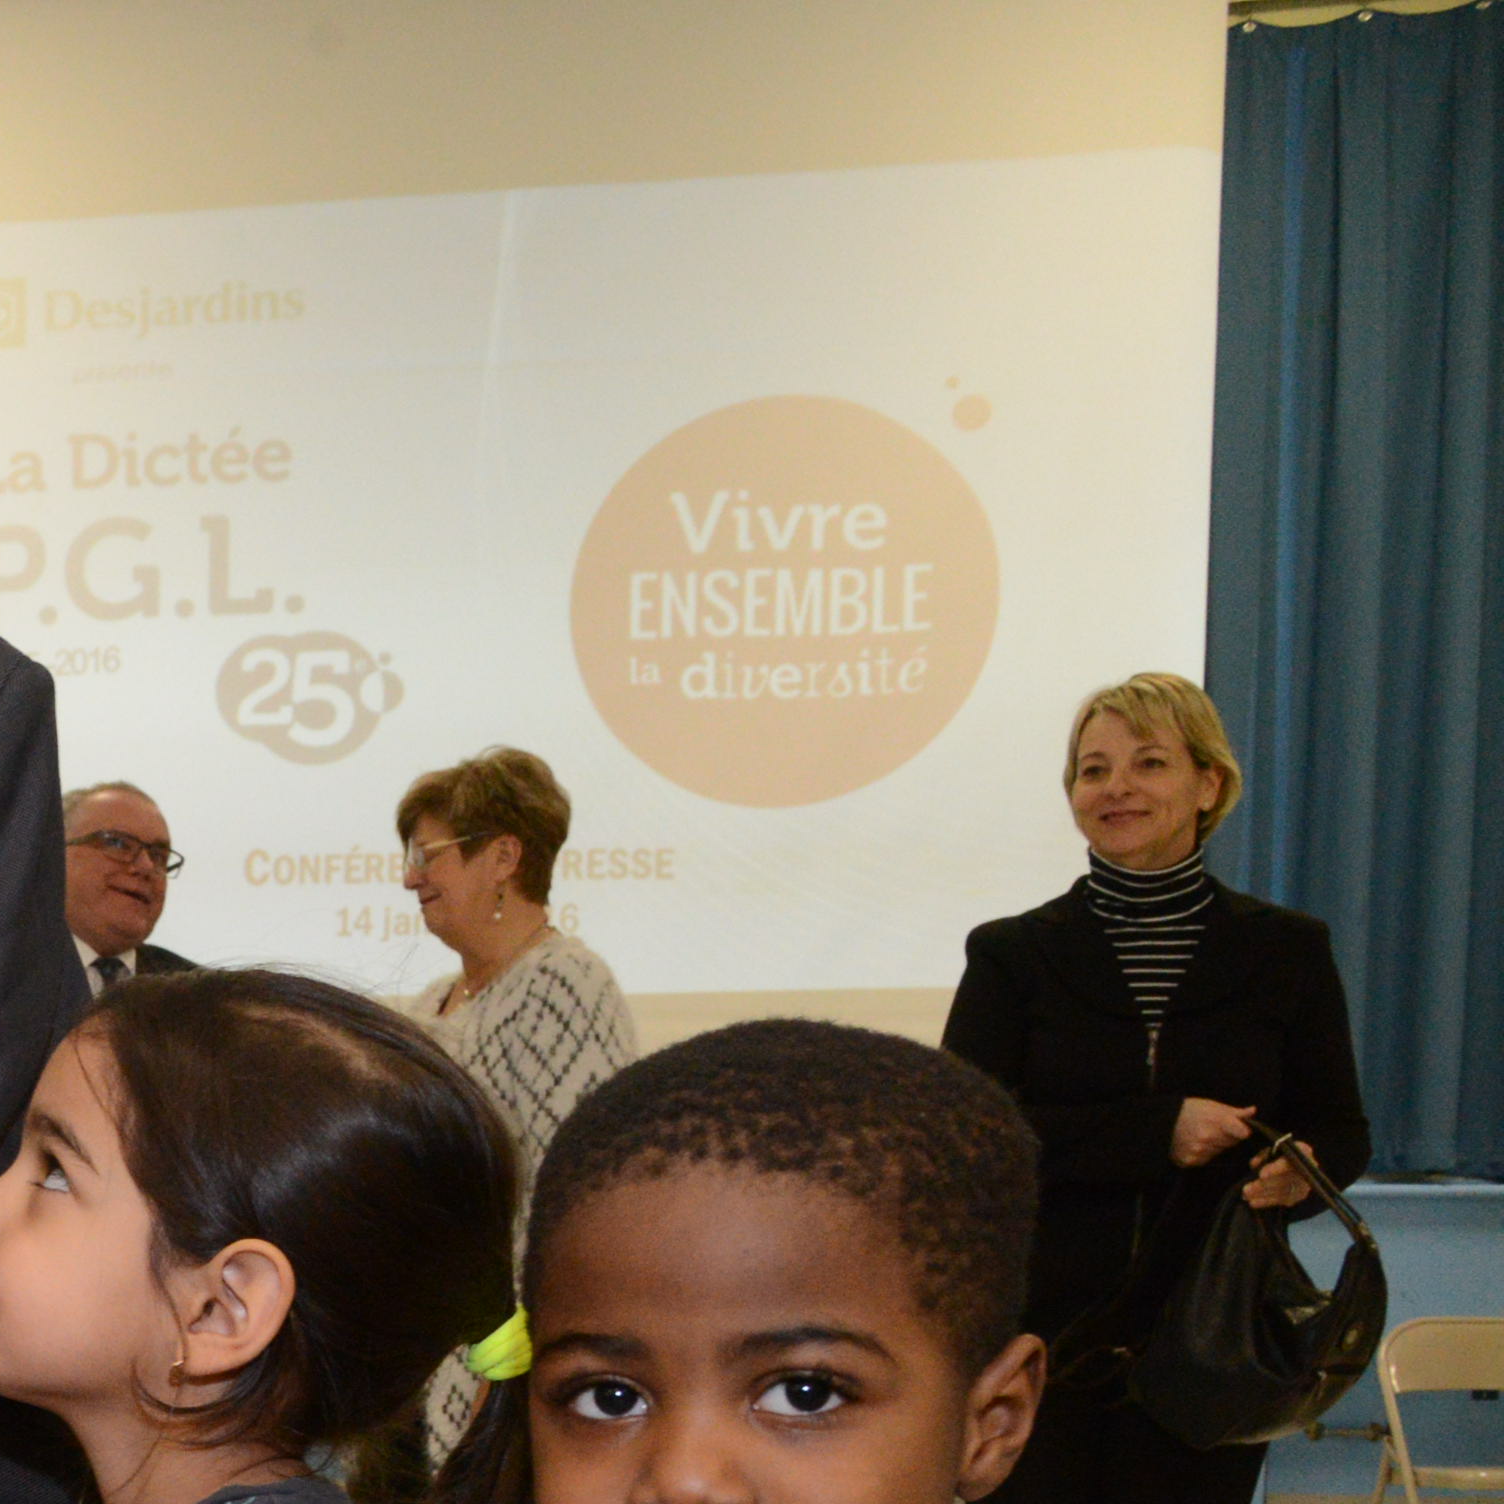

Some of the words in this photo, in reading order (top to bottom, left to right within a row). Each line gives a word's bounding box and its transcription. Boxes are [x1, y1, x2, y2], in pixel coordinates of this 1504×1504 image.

[45, 280, 307, 340] Desjardins
[67, 426, 294, 490] Dictée
[669, 489, 889, 554] Vivre
[629, 563, 935, 640] ENSEMBLE
[629, 656, 663, 686] la
[680, 646, 930, 700] diversité
[244, 843, 403, 887] CONFÉRE
[562, 847, 676, 880] RESSE
[336, 906, 374, 937] 14
